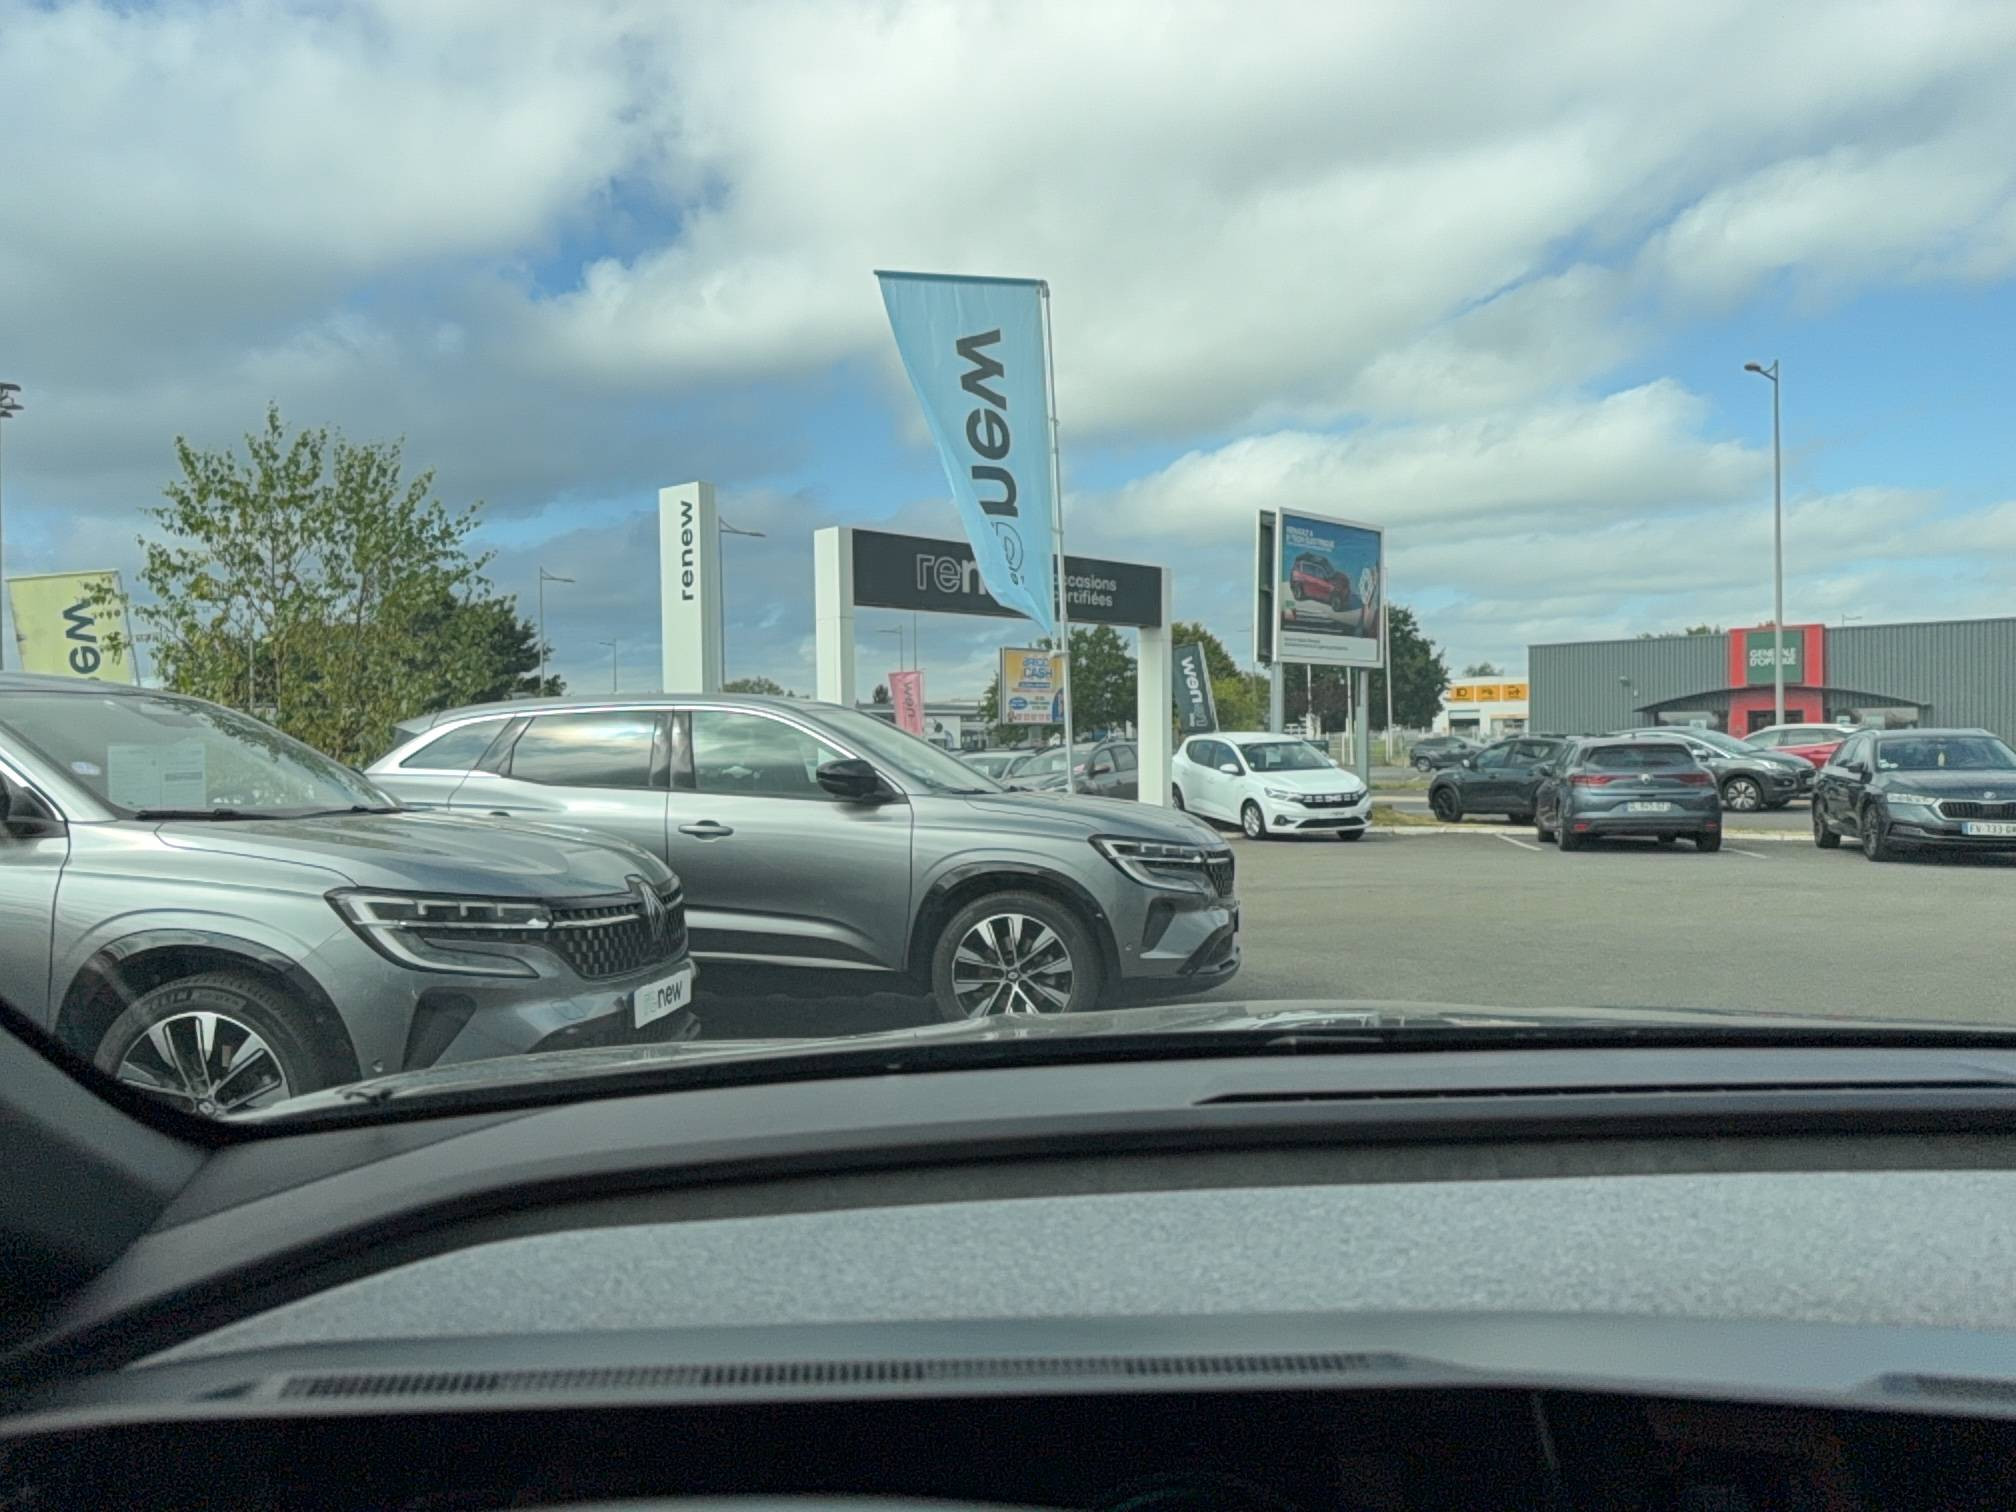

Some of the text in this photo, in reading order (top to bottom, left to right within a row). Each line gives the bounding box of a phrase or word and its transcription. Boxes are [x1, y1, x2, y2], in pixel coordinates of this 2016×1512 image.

[680, 501, 695, 601] renew
[916, 553, 987, 595] ren
[1054, 574, 1117, 591] casions
[1054, 590, 1113, 607] rtifiées
[1750, 648, 1796, 658] GENEALE
[1750, 657, 1796, 667] D'OPTUE
